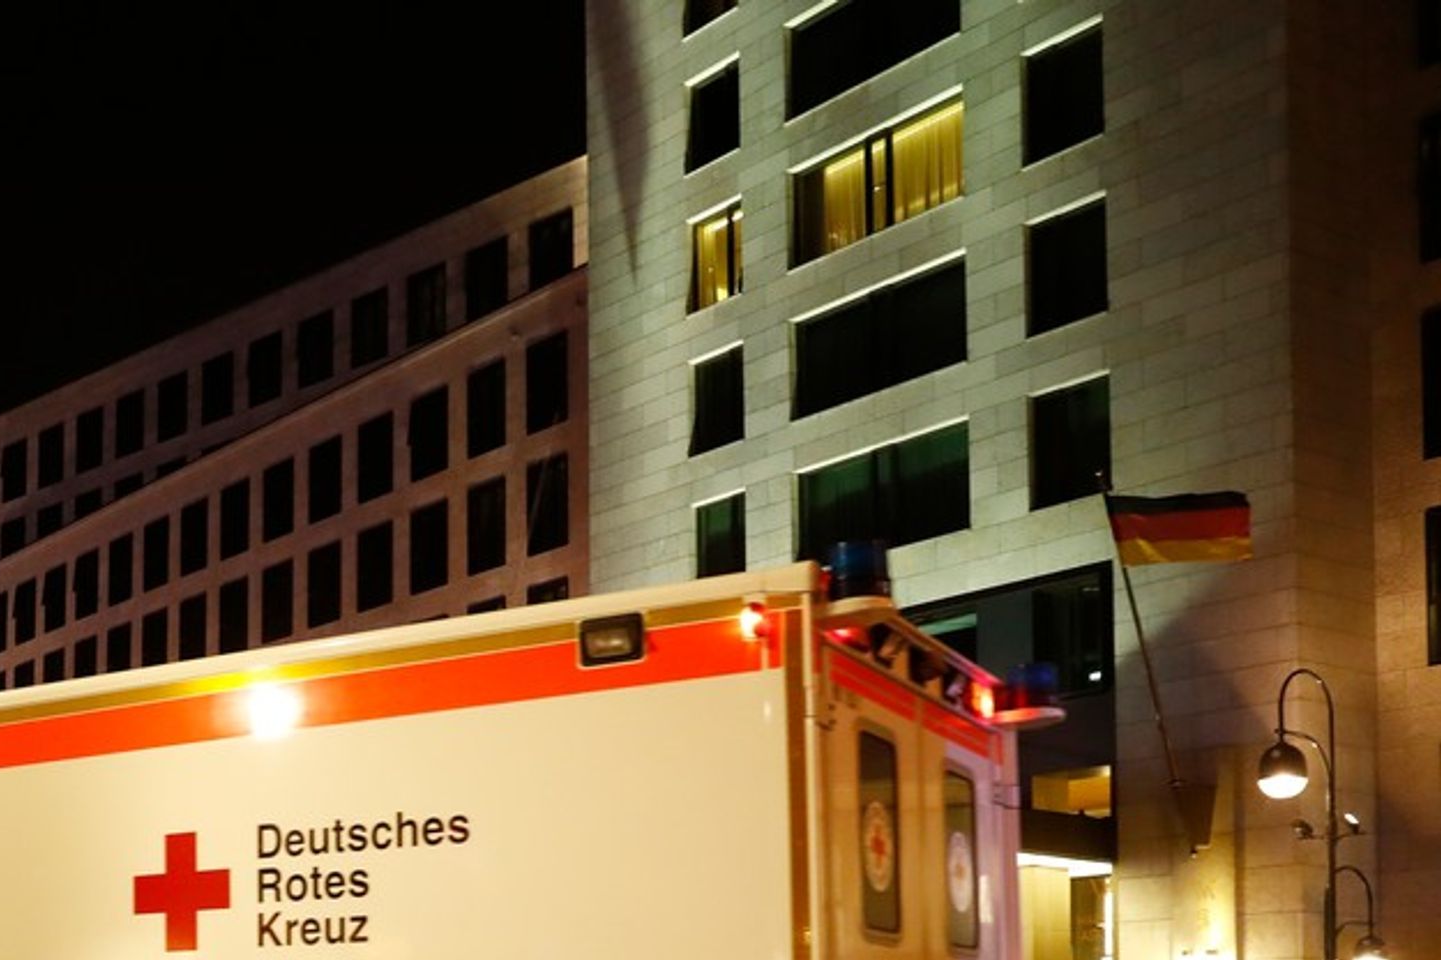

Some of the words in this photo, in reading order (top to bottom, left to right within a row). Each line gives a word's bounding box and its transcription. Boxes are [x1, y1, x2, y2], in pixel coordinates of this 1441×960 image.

[256, 811, 470, 859] Deutsches
[256, 866, 370, 904] Rotes
[256, 911, 370, 948] Kreuz
